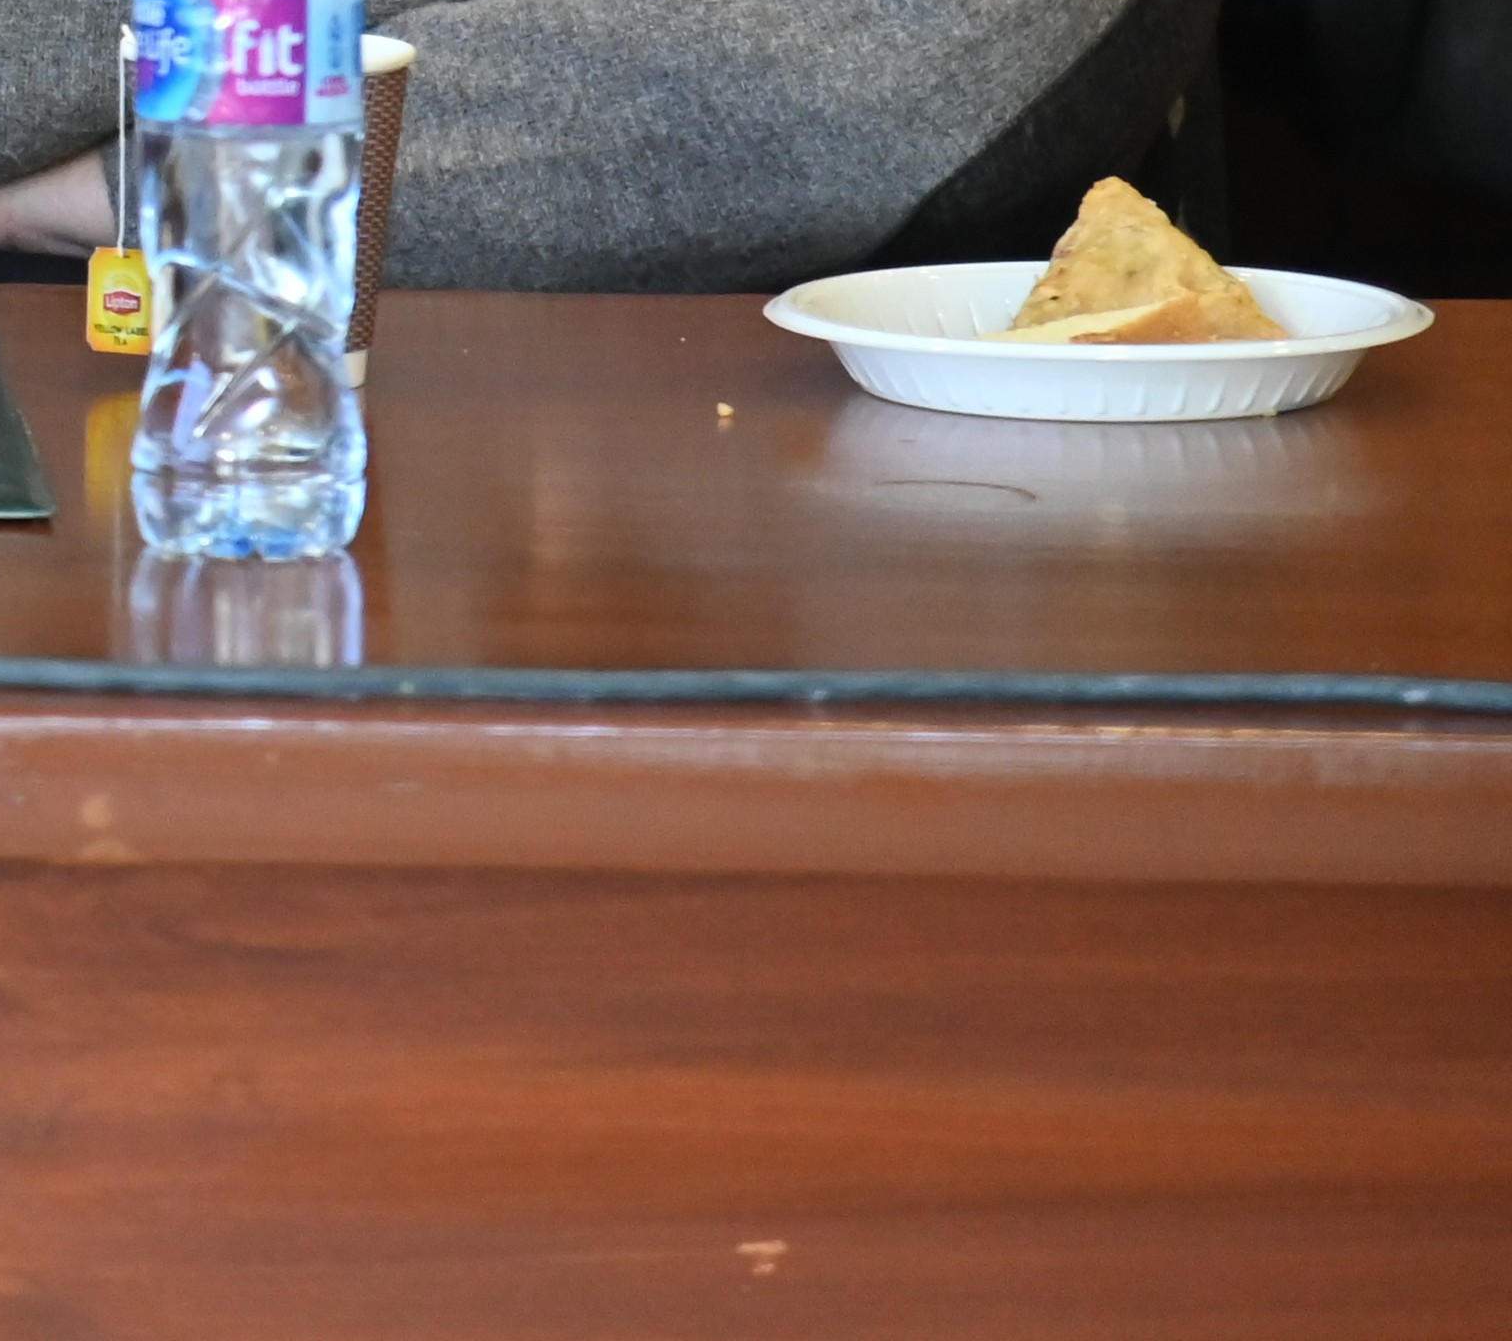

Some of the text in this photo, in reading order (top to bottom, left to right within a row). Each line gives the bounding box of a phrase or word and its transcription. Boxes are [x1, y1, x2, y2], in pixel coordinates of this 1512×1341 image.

[231, 18, 304, 77] fit
[94, 323, 124, 334] YELLOW
[113, 335, 129, 346] TEA
